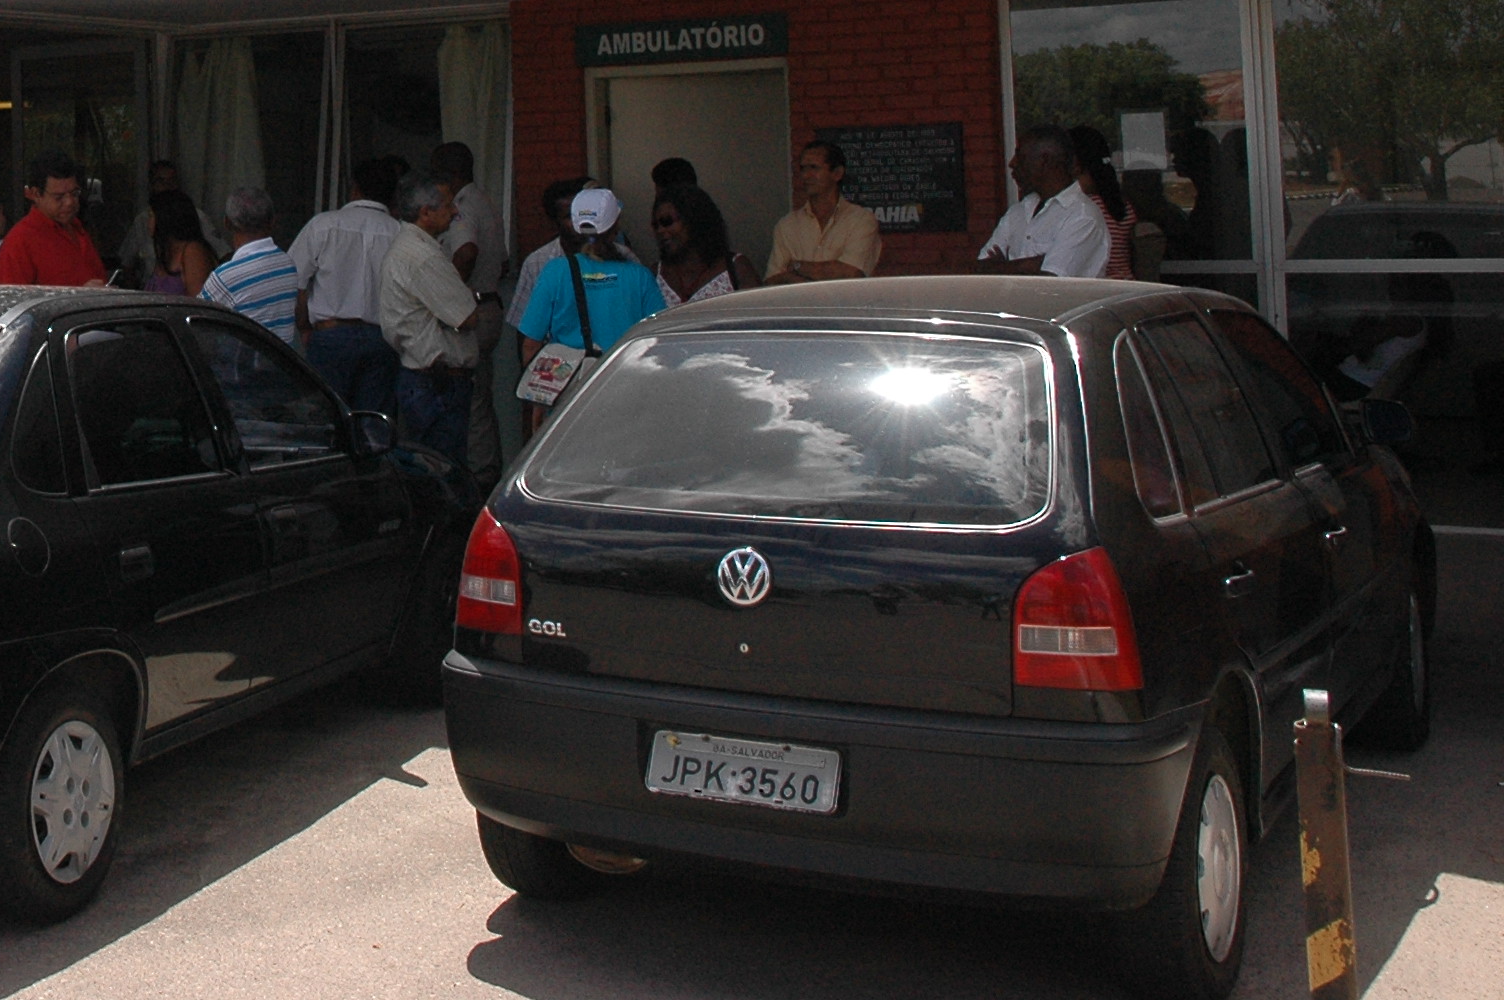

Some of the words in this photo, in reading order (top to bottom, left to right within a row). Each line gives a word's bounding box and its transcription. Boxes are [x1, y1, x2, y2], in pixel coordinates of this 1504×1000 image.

[597, 21, 765, 56] AMBULATÓRIO
[864, 205, 921, 223] AHIA
[528, 617, 567, 638] GOL
